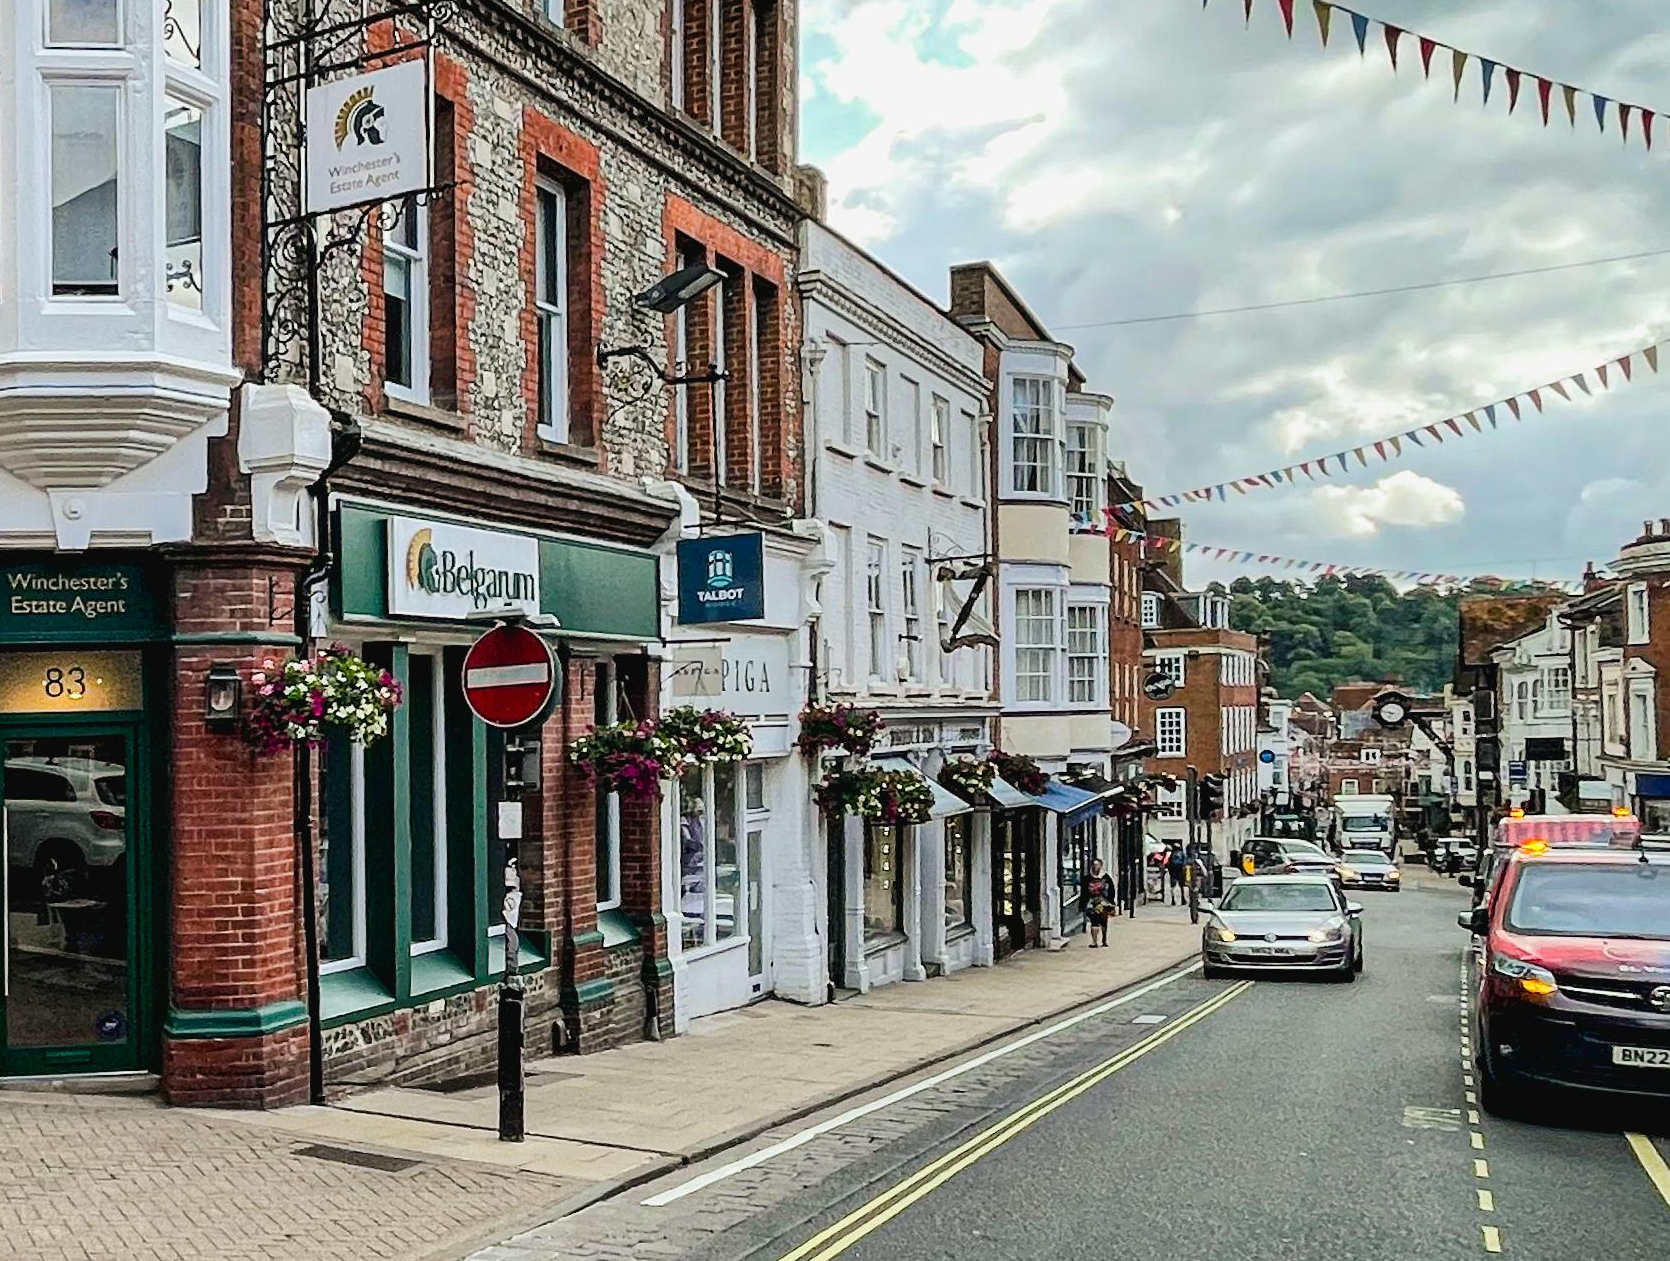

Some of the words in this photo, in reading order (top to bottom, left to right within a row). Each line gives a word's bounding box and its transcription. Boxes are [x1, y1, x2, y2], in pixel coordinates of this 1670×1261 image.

[330, 180, 363, 194] Estate
[365, 170, 400, 187] Agent
[8, 572, 129, 590] Winchester's
[441, 549, 535, 609] Belgarum
[697, 588, 744, 602] TALBOT
[11, 596, 67, 613] Estate
[70, 596, 126, 618] Agent
[45, 667, 86, 698] 83
[721, 659, 770, 693] PIGA
[1622, 1048, 1669, 1065] BN22
